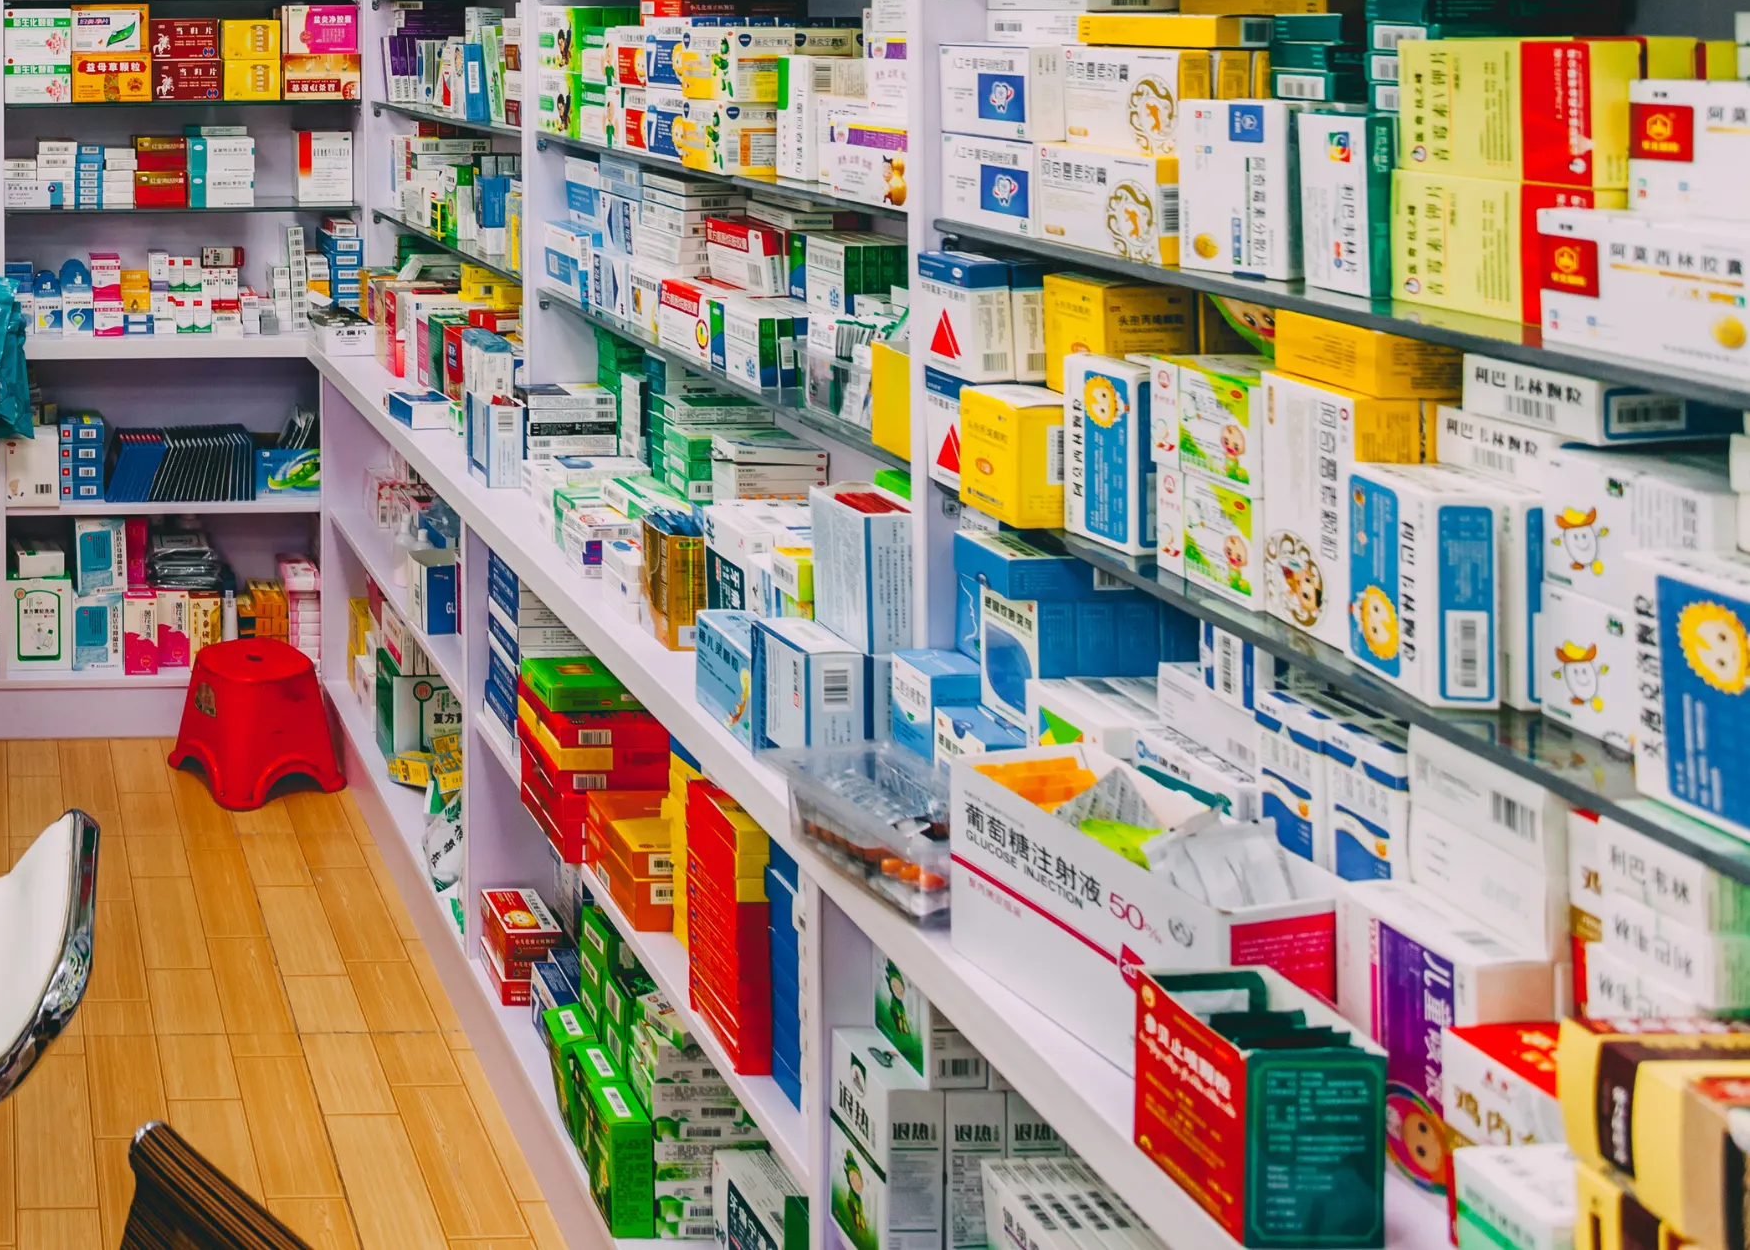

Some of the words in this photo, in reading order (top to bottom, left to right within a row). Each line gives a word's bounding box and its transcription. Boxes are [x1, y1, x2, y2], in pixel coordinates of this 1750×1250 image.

[13, 17, 55, 27] 新生化颗粒
[176, 26, 213, 35] 当归片
[13, 65, 55, 74] 新生化颗粒
[86, 62, 141, 72] 益母草颗粒
[179, 67, 217, 76] 当归片
[1251, 157, 1267, 267] 阿奇霉素分散片
[1340, 183, 1358, 276] 利巴韦林片
[1609, 243, 1743, 276] 阿莫西林胶囊
[1119, 314, 1185, 327] 头孢丙烯颗粒
[1474, 365, 1582, 407] 利巴韦林颗粒
[1445, 418, 1538, 458] 利巴韦林颗粒
[1319, 401, 1338, 562] 阿奇霉素颗粒
[1400, 520, 1416, 663] 利巴韦林颗粒
[964, 801, 1102, 908] 葡萄糖注射液
[966, 830, 1018, 869] GLUCOSE
[1024, 866, 1083, 910] INJECTION
[1609, 845, 1691, 906] 利巴韦林
[838, 1080, 869, 1143] 退热
[892, 1121, 929, 1142] 退热
[954, 1123, 992, 1143] 退热
